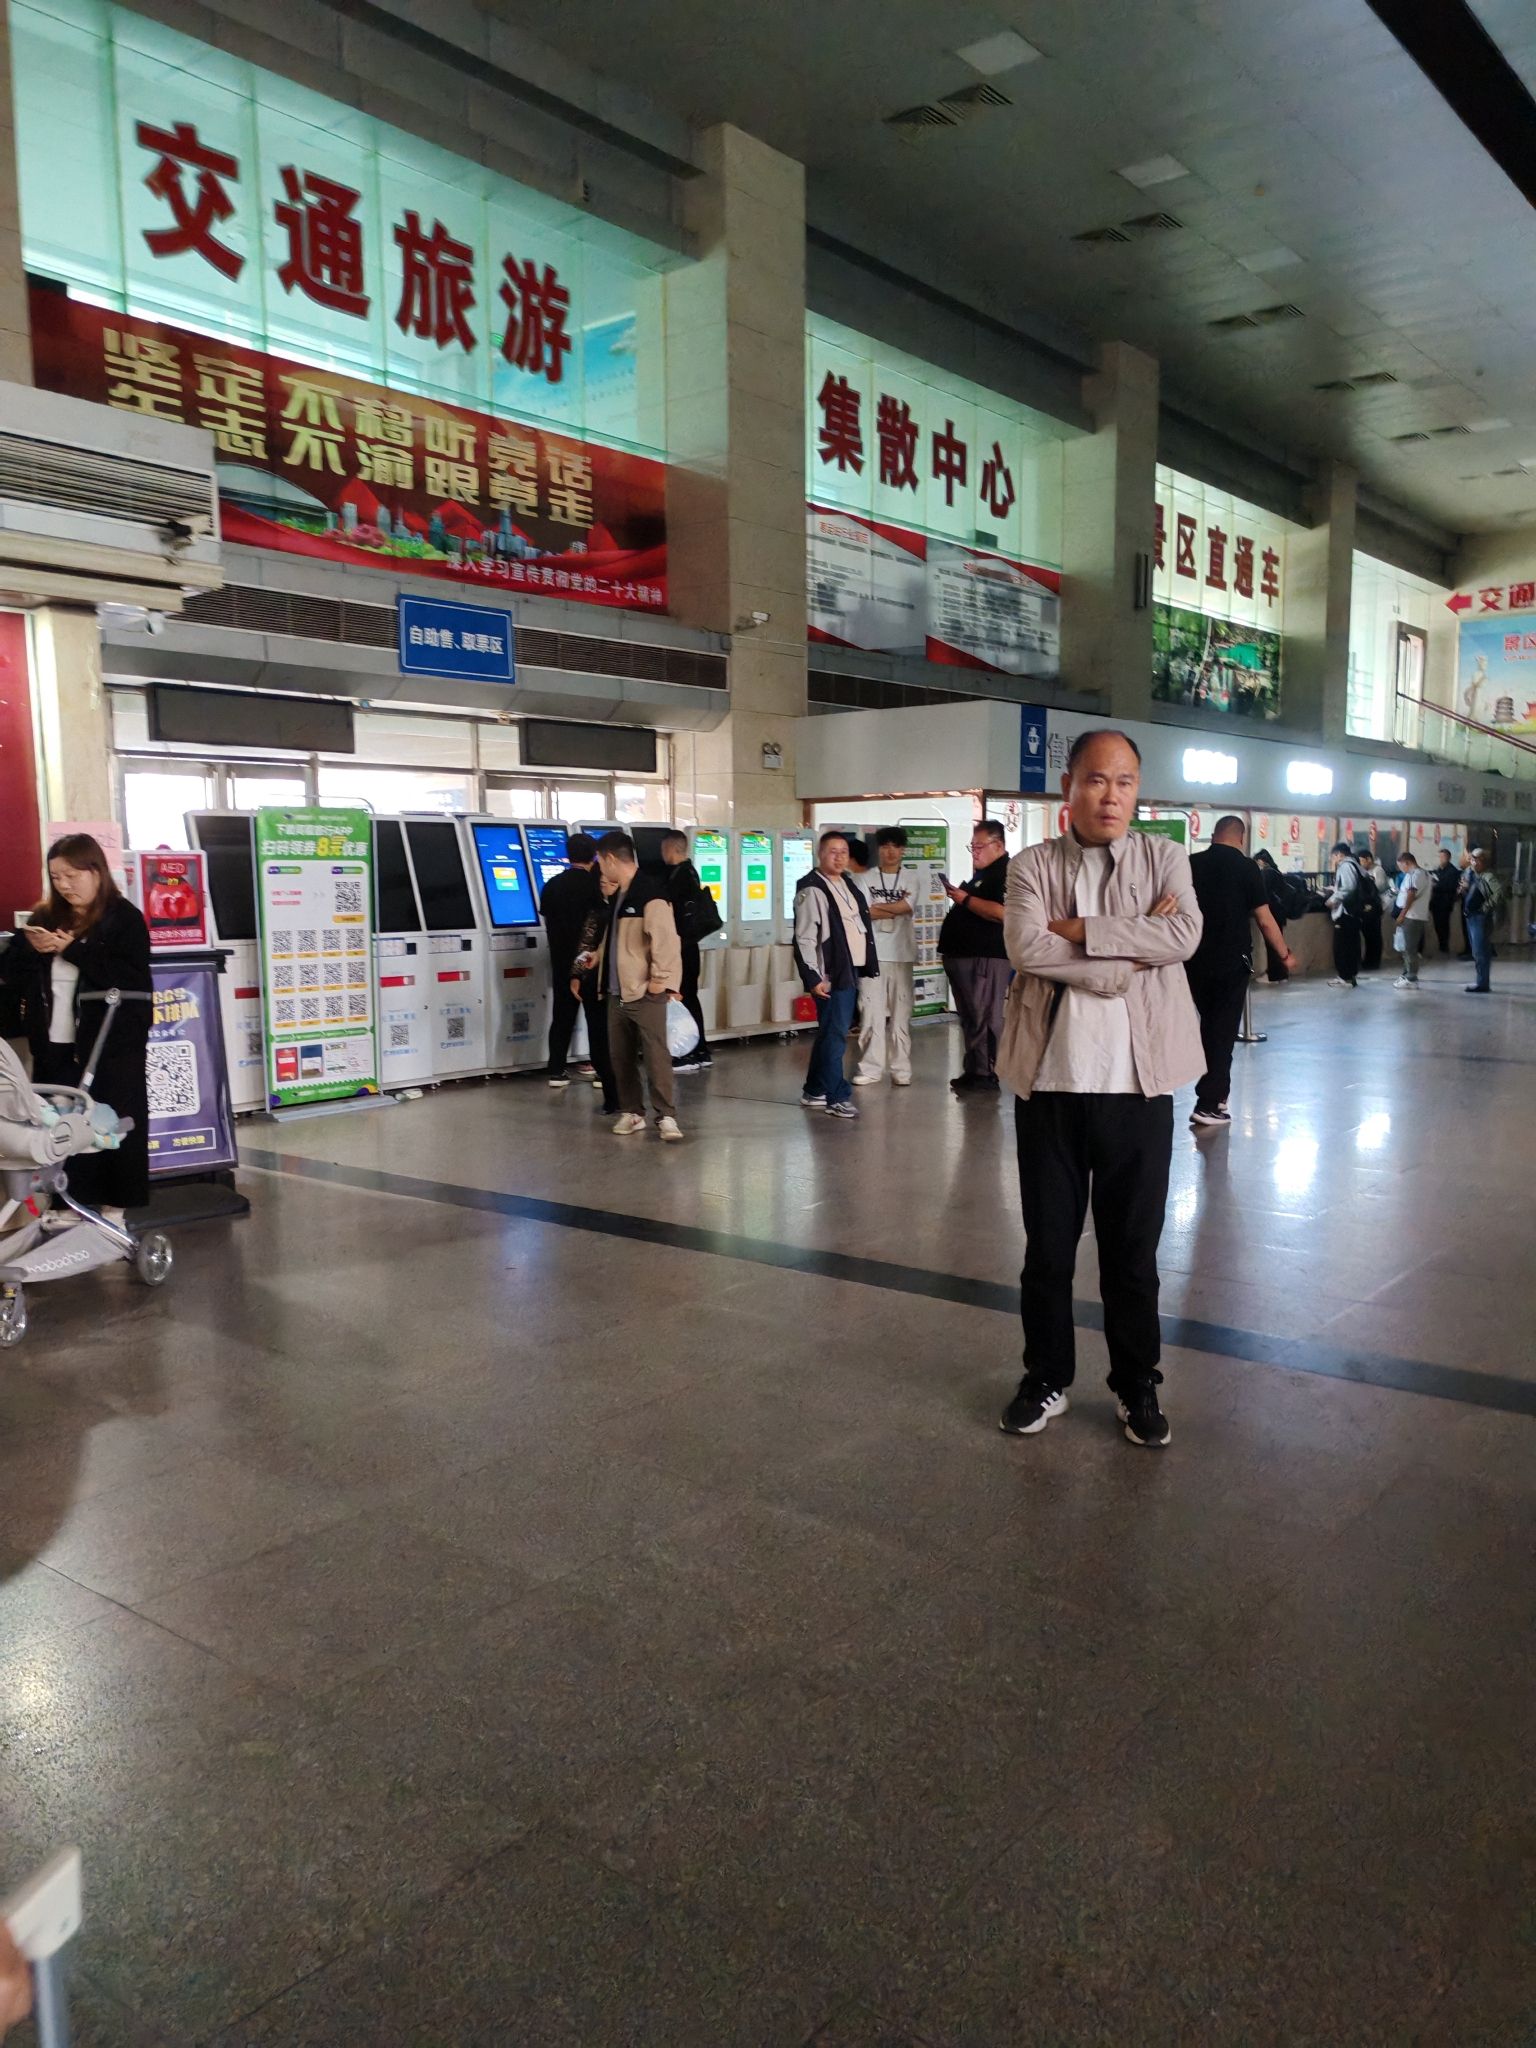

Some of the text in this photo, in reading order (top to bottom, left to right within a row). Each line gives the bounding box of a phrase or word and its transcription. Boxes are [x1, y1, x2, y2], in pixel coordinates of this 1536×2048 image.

[135, 119, 572, 384] 交通旅游
[103, 327, 593, 491] 坚定不移听党话
[817, 370, 1016, 520] 集散中心
[160, 862, 186, 874] AED
